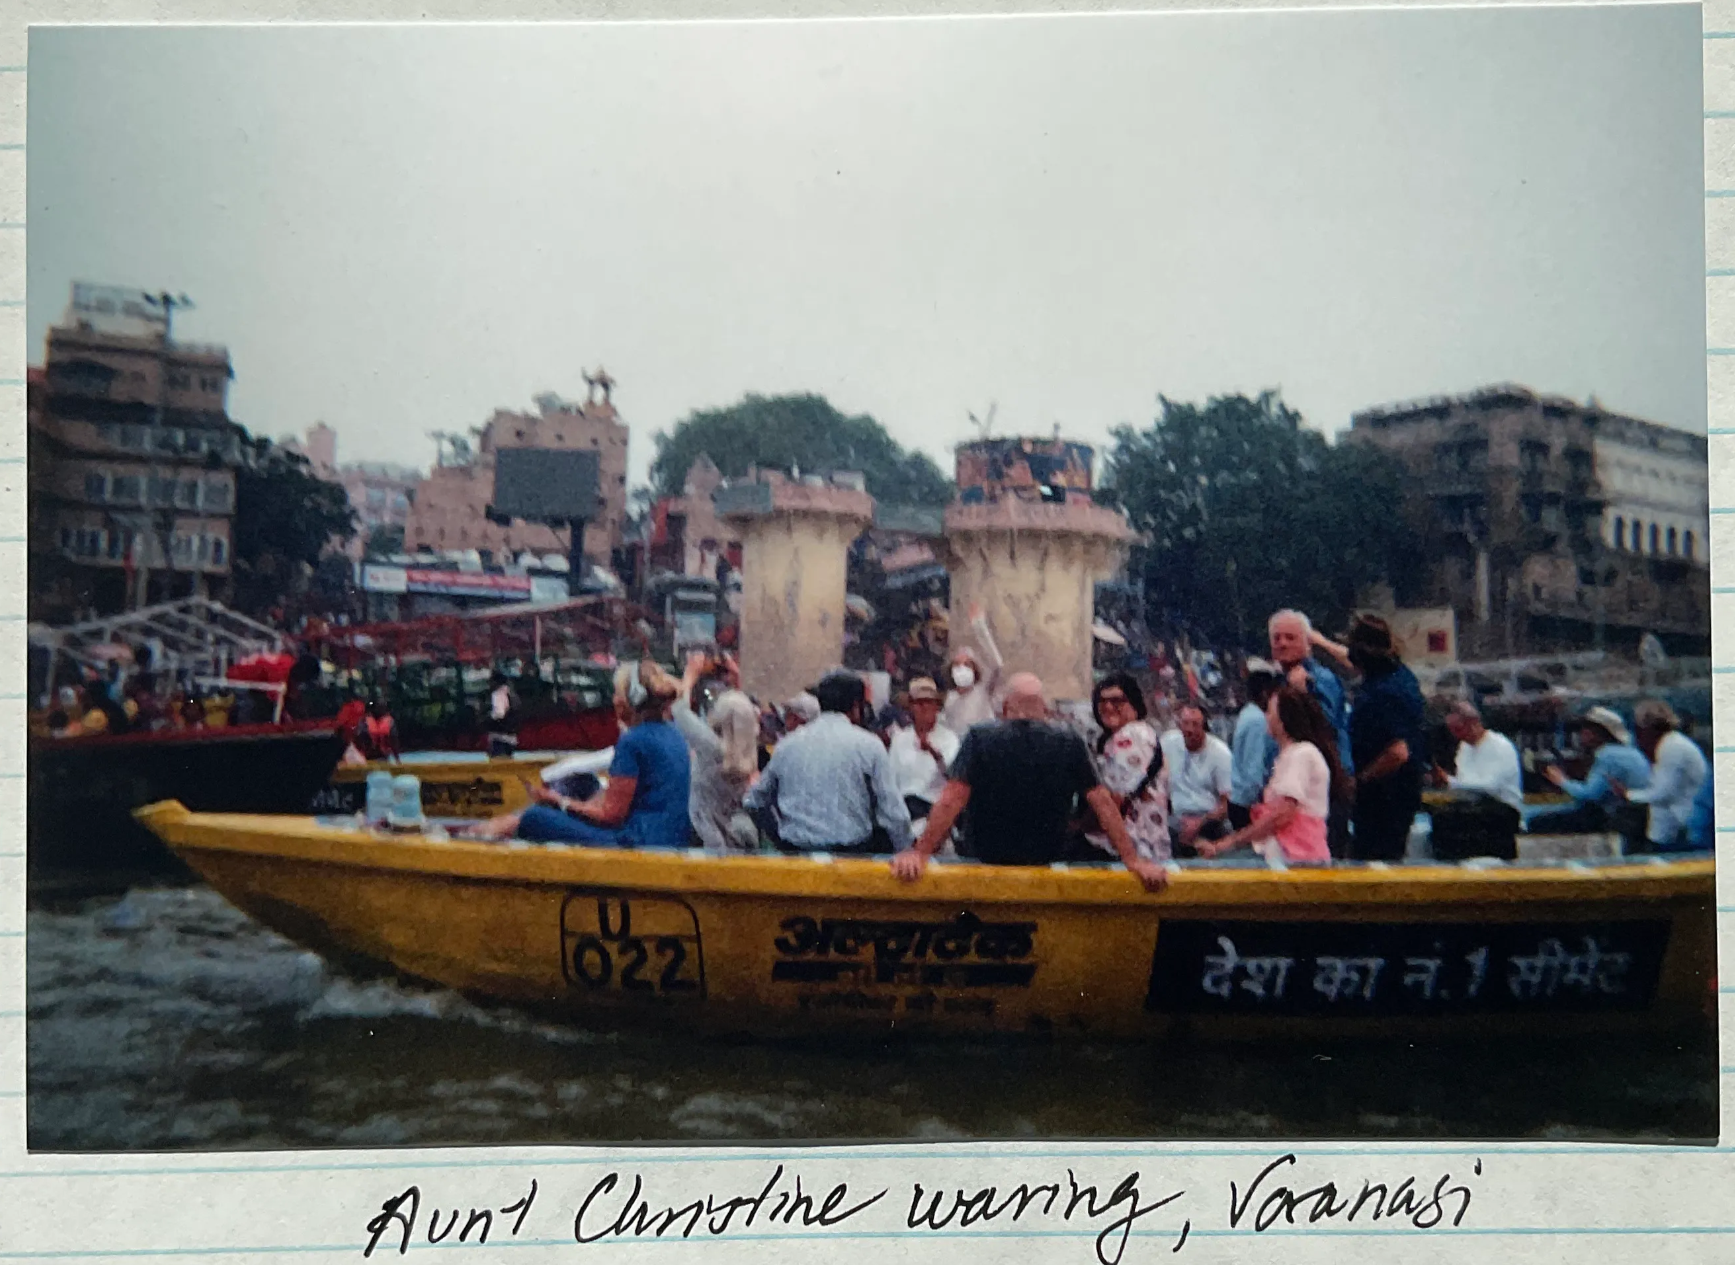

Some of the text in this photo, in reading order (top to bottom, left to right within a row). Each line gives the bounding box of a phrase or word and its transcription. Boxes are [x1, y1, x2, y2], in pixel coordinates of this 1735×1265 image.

[597, 894, 631, 941] U
[573, 935, 698, 991] 022
[1201, 935, 1295, 1000] देश
[1312, 956, 1387, 1002] का
[364, 1179, 537, 1258] Aunt
[575, 1165, 888, 1244] Christine
[1231, 1155, 1482, 1233] Varanasi
